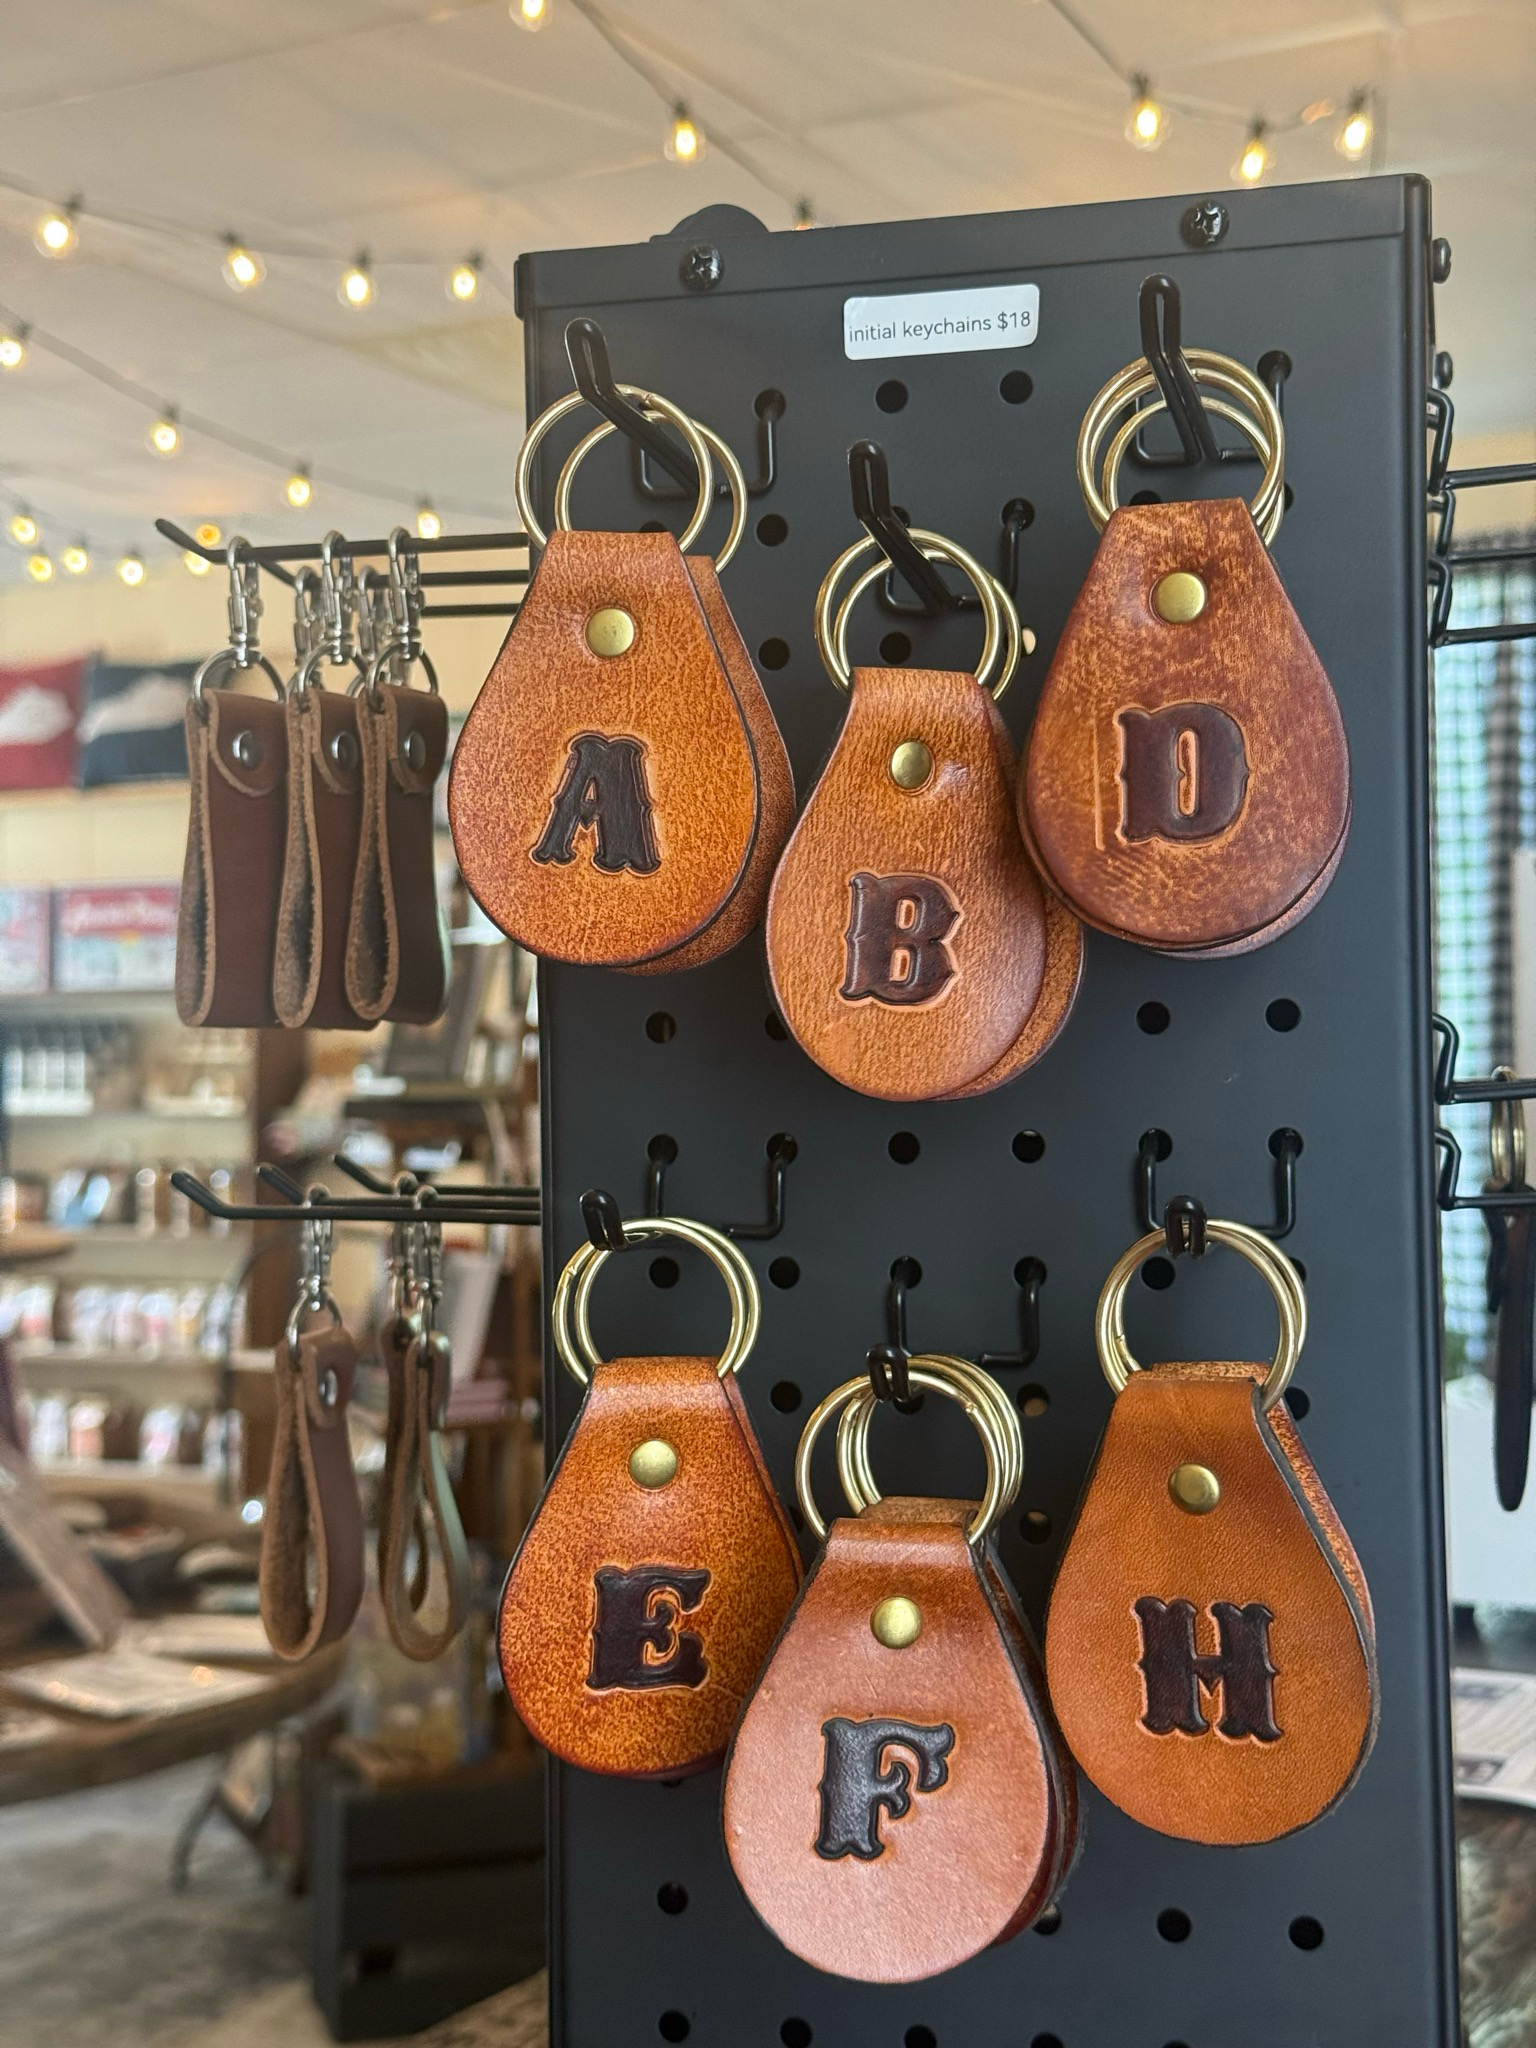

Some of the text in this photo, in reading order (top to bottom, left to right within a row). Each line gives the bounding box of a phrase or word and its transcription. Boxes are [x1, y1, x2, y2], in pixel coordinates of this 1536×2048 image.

[849, 311, 1031, 342] initial keychains $18
[533, 732, 661, 874] A
[1115, 703, 1249, 843] D
[841, 871, 963, 1004] B
[586, 1565, 711, 1695] E
[1132, 1597, 1281, 1741] H
[815, 1717, 955, 1859] F
